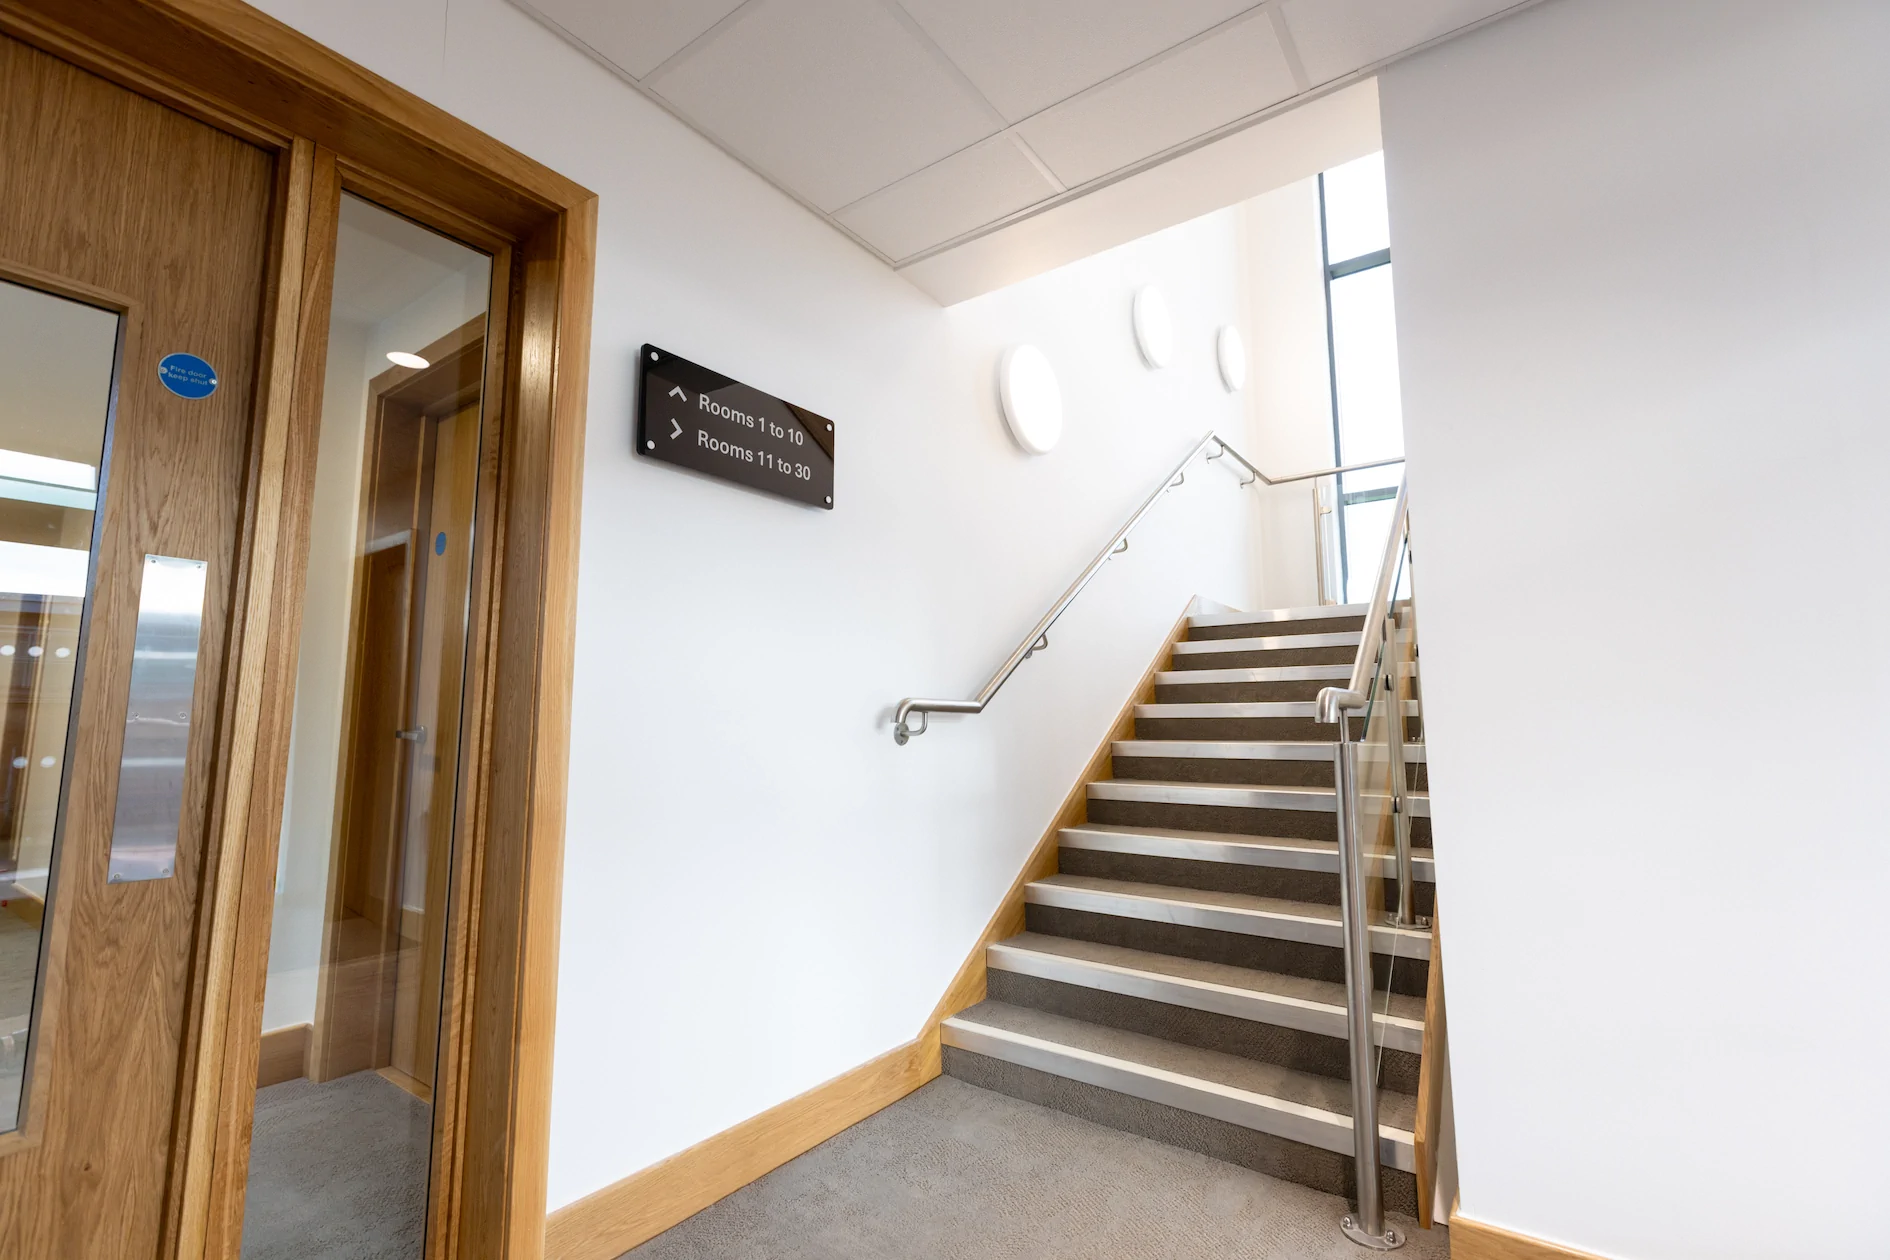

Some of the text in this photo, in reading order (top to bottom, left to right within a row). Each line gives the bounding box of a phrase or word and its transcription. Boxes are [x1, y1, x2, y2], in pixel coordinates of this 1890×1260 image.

[168, 372, 188, 382] keep
[170, 365, 207, 379] Fire door
[699, 393, 804, 446] Rooms 1 to 10
[697, 429, 811, 481] Rooms 11 to 30
